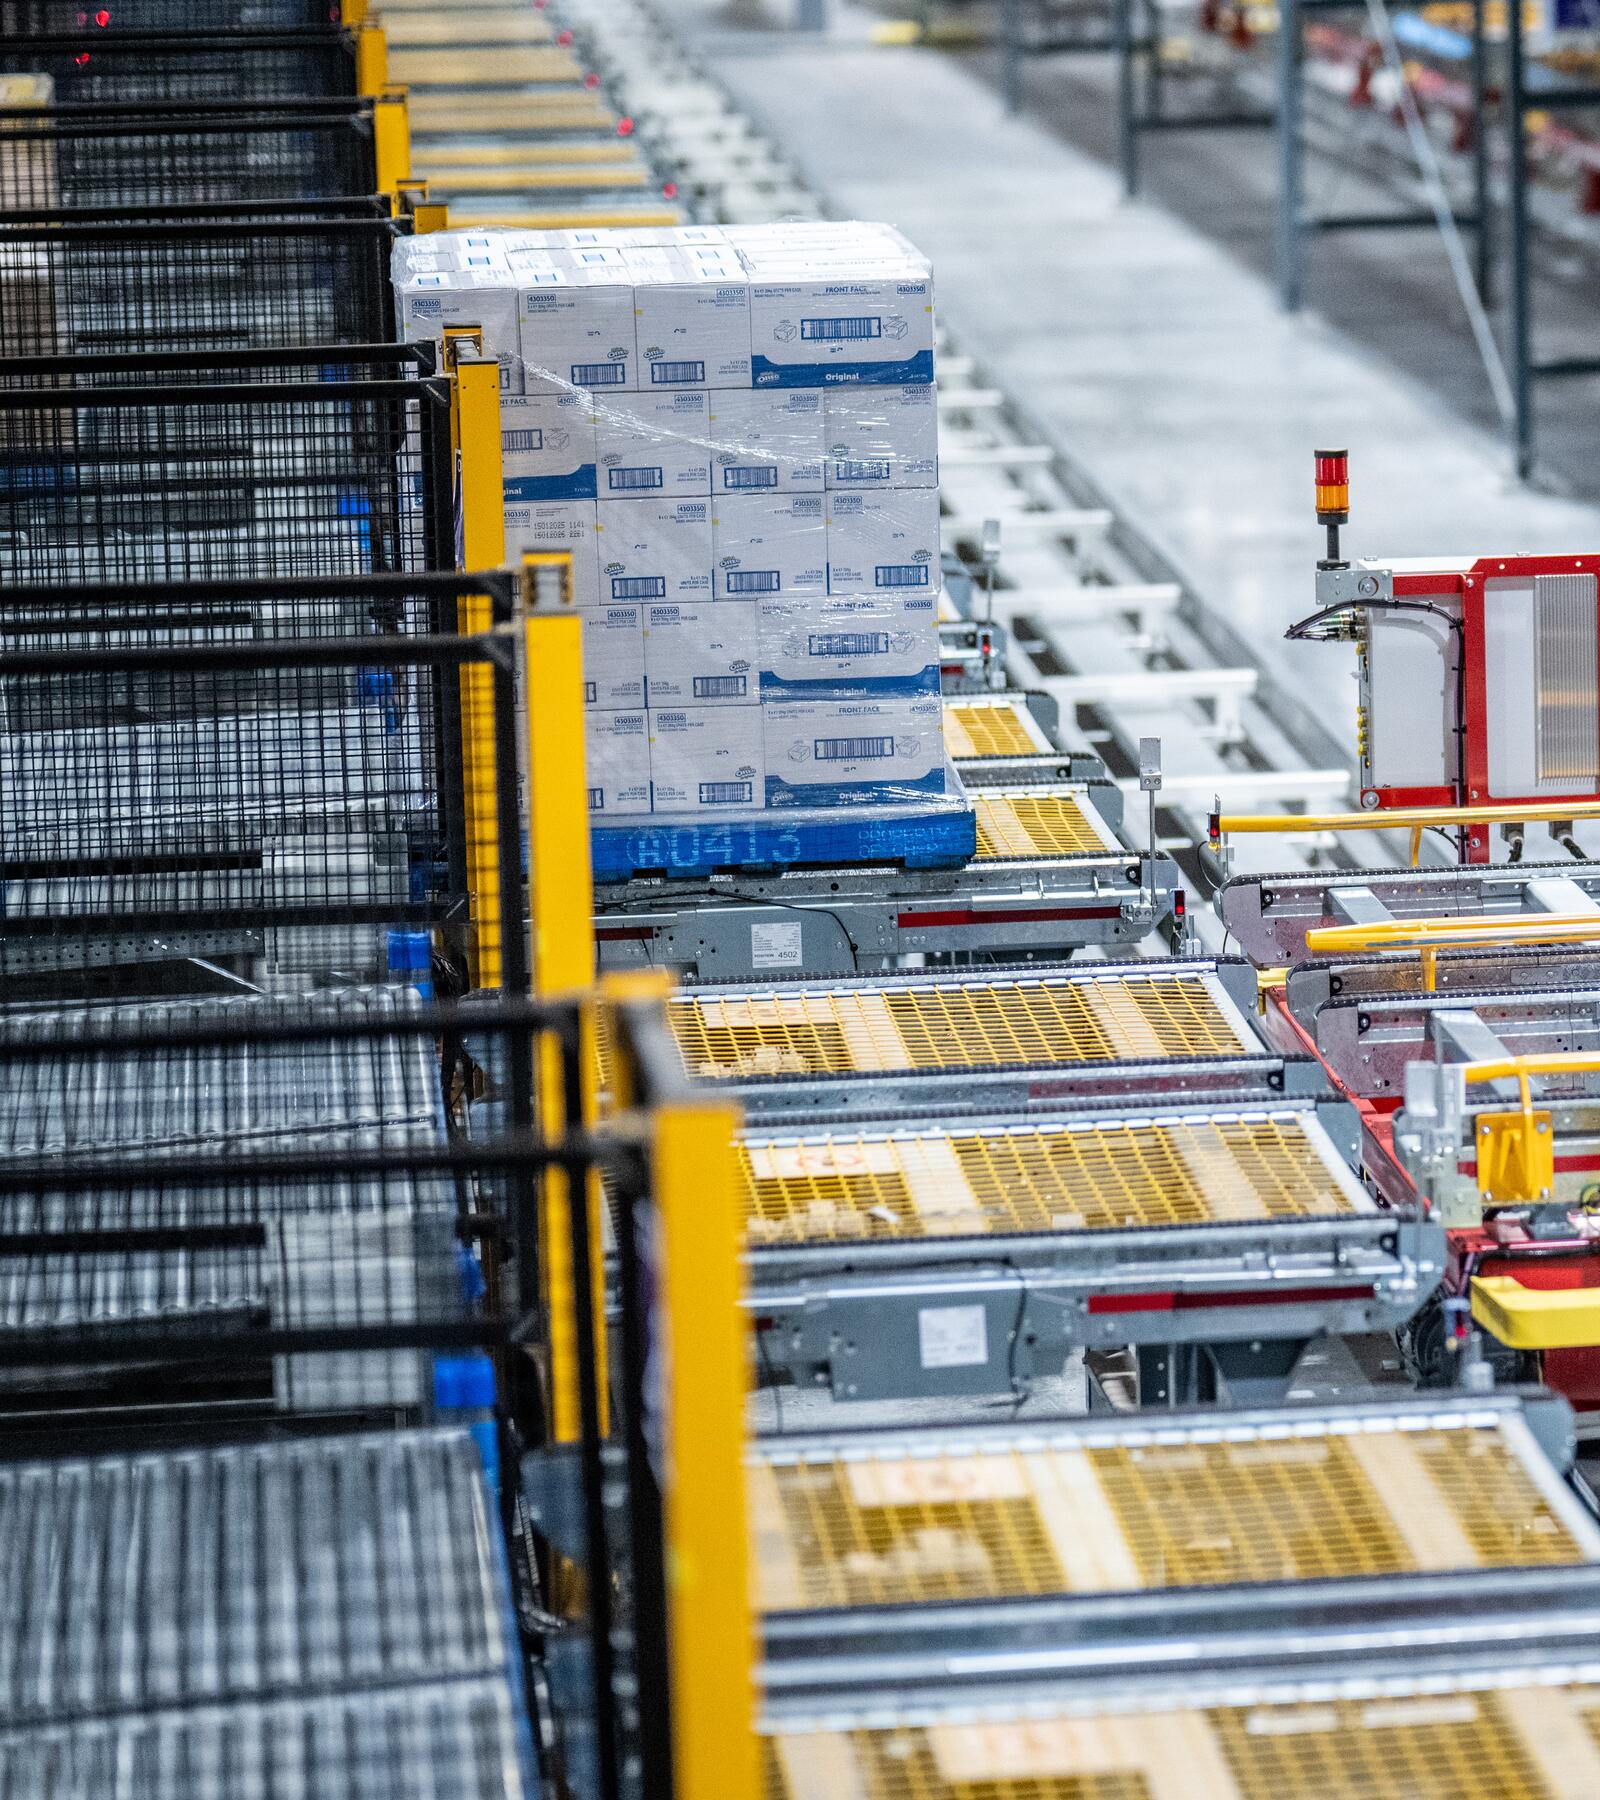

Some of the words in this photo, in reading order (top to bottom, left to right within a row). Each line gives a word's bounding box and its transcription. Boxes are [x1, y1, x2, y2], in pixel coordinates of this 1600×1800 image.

[826, 373, 860, 381] Original
[678, 505, 705, 513] 4303350
[609, 610, 635, 618] 4303350
